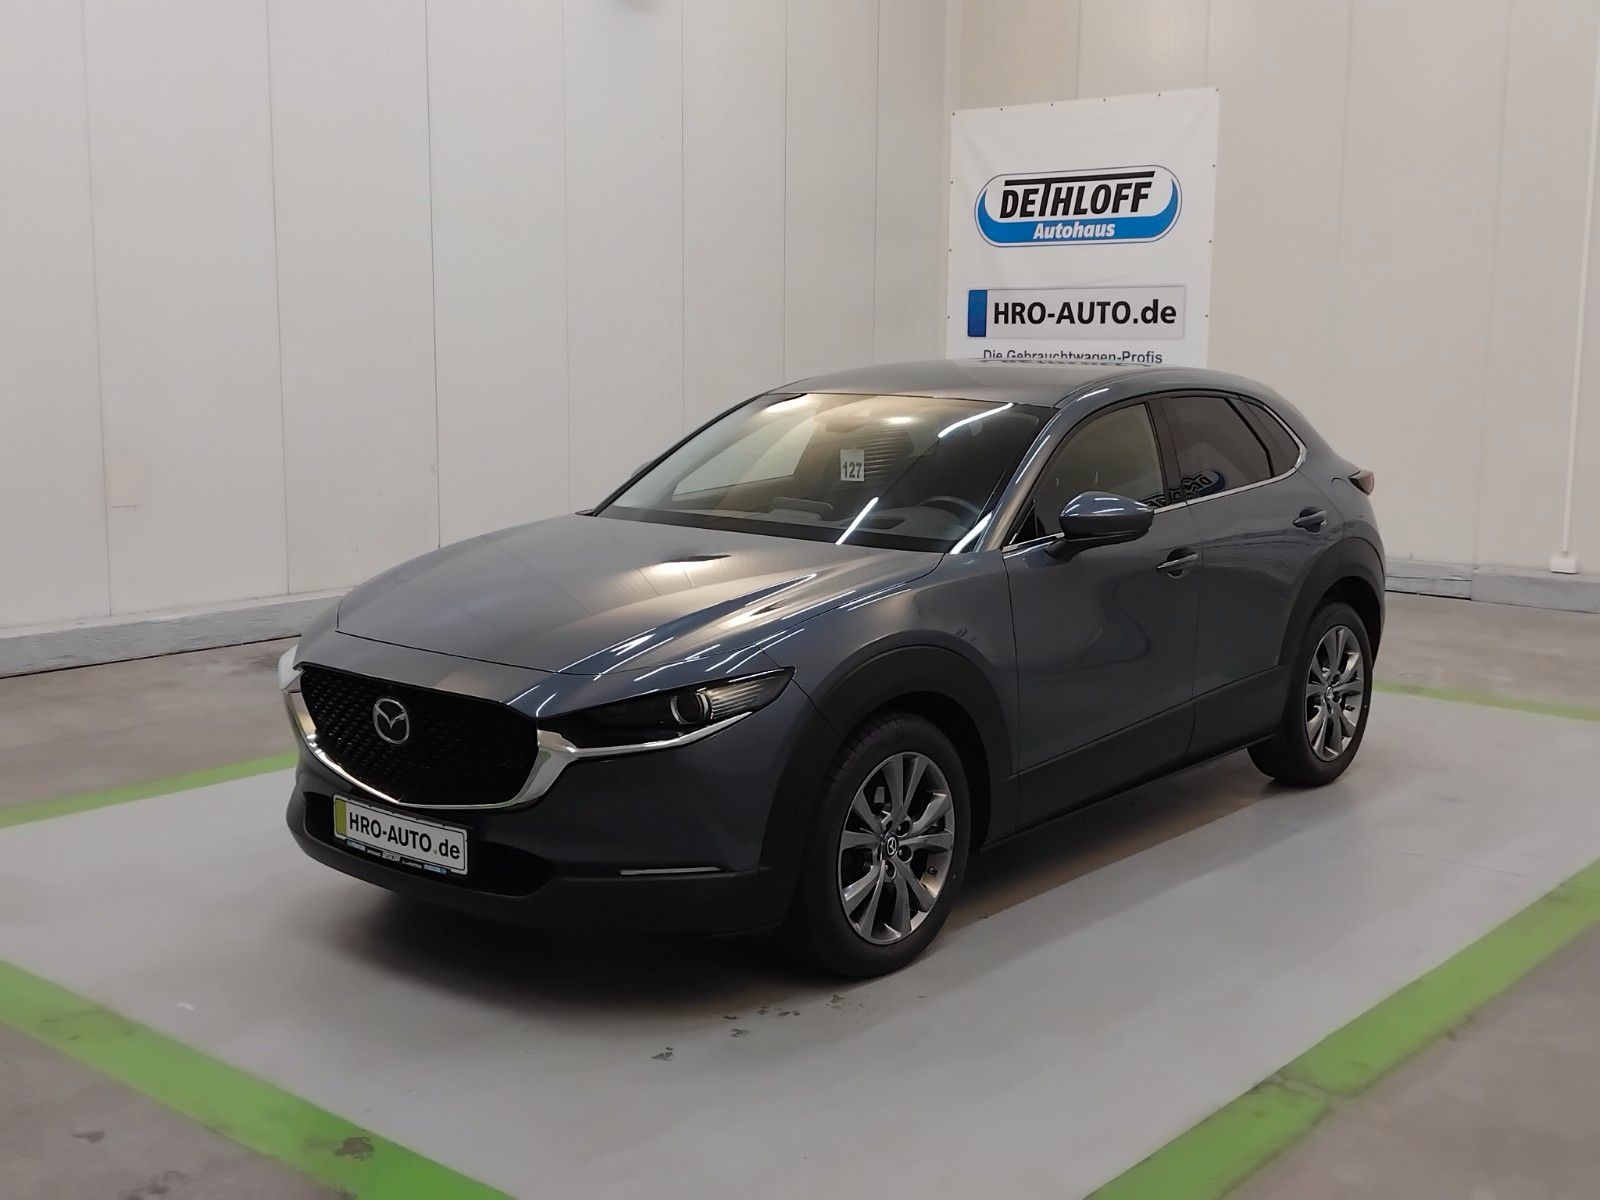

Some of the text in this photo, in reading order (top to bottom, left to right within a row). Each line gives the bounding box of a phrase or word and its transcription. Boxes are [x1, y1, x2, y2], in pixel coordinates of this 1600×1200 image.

[1000, 171, 1155, 219] DETHLOFF
[1033, 222, 1116, 240] Autohaus
[993, 299, 1177, 325] HRO-AUTO.de
[983, 349, 1003, 359] Die
[843, 461, 862, 479] 127
[349, 811, 460, 860] HRO-AUTO.de
